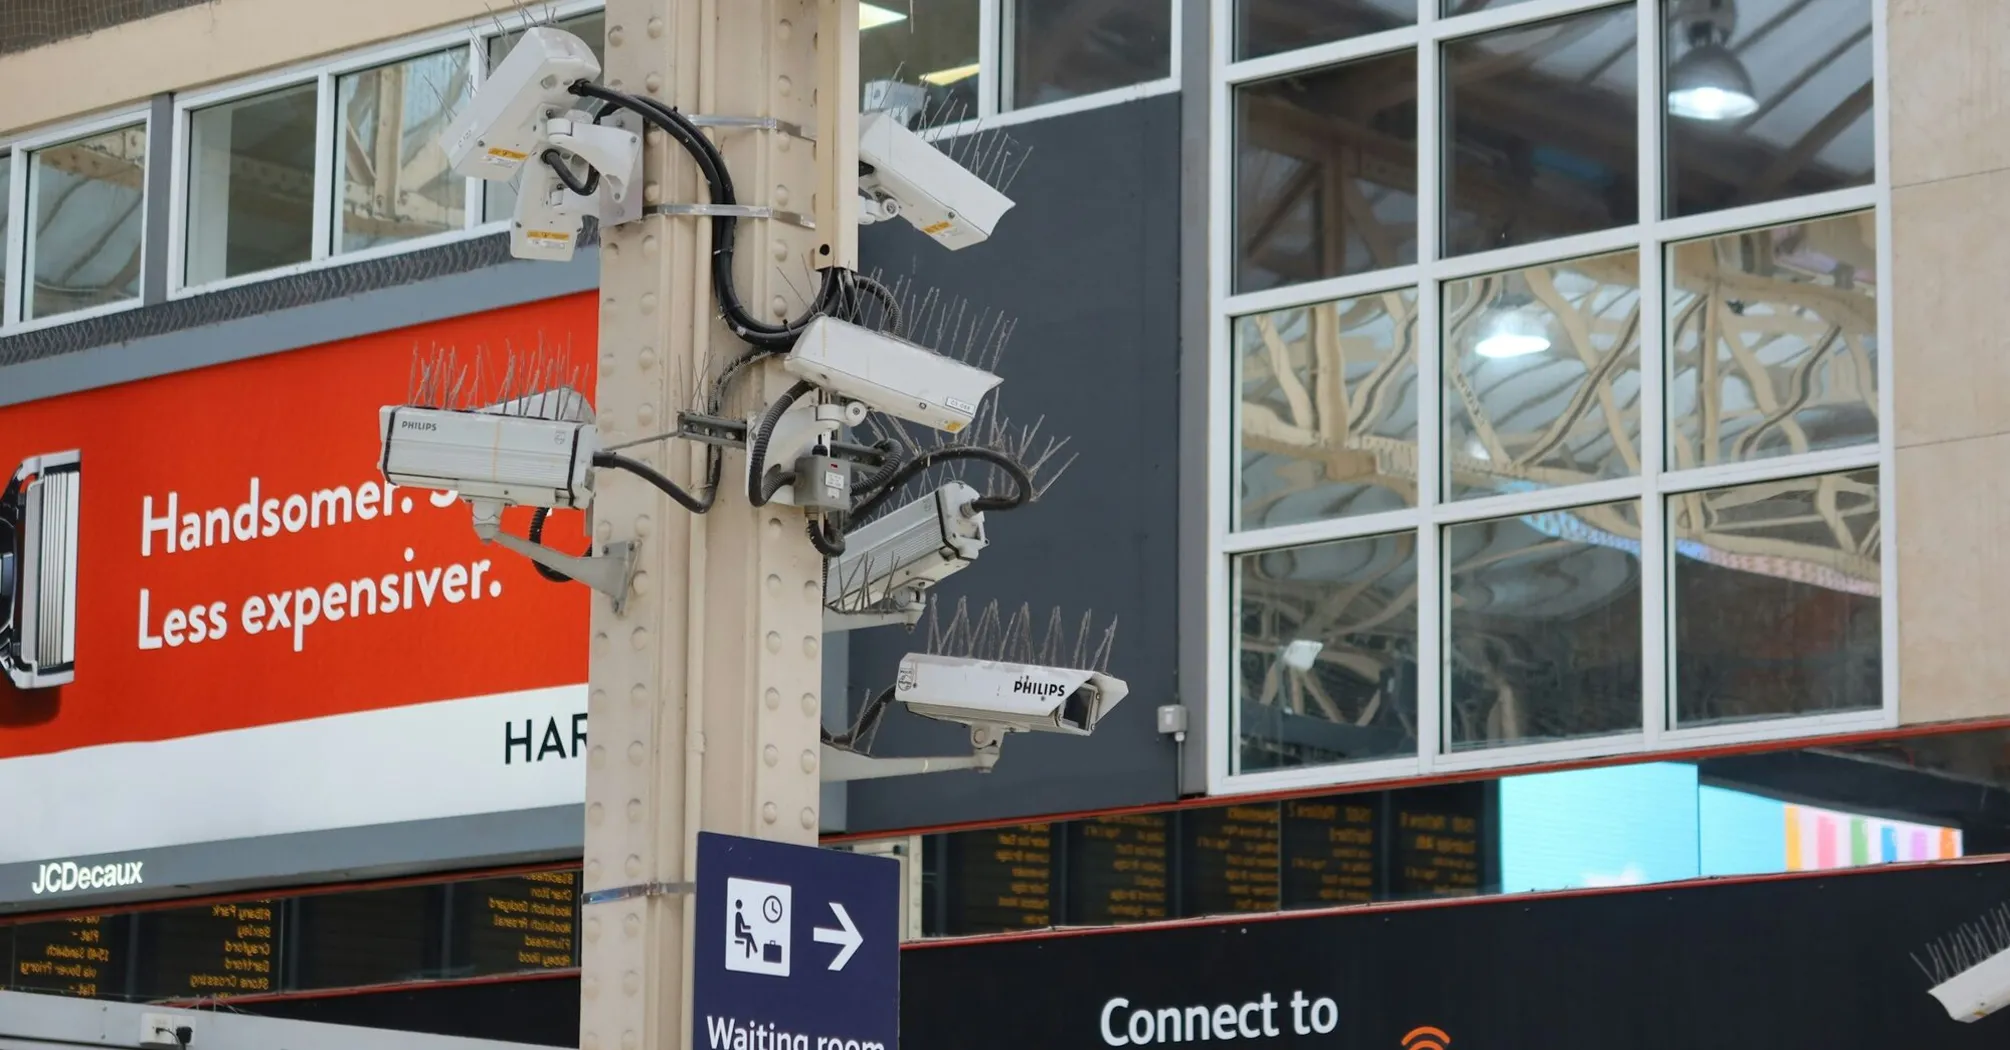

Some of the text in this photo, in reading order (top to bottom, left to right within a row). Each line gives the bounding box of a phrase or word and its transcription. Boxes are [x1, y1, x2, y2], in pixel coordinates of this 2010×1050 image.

[402, 420, 437, 432] PHILIPS
[141, 477, 413, 557] Handsomer.
[138, 547, 502, 652] Less expensiver.
[1013, 680, 1065, 697] PHILIPS
[31, 861, 144, 894] JCDecaux
[1100, 990, 1338, 1046] Connect to
